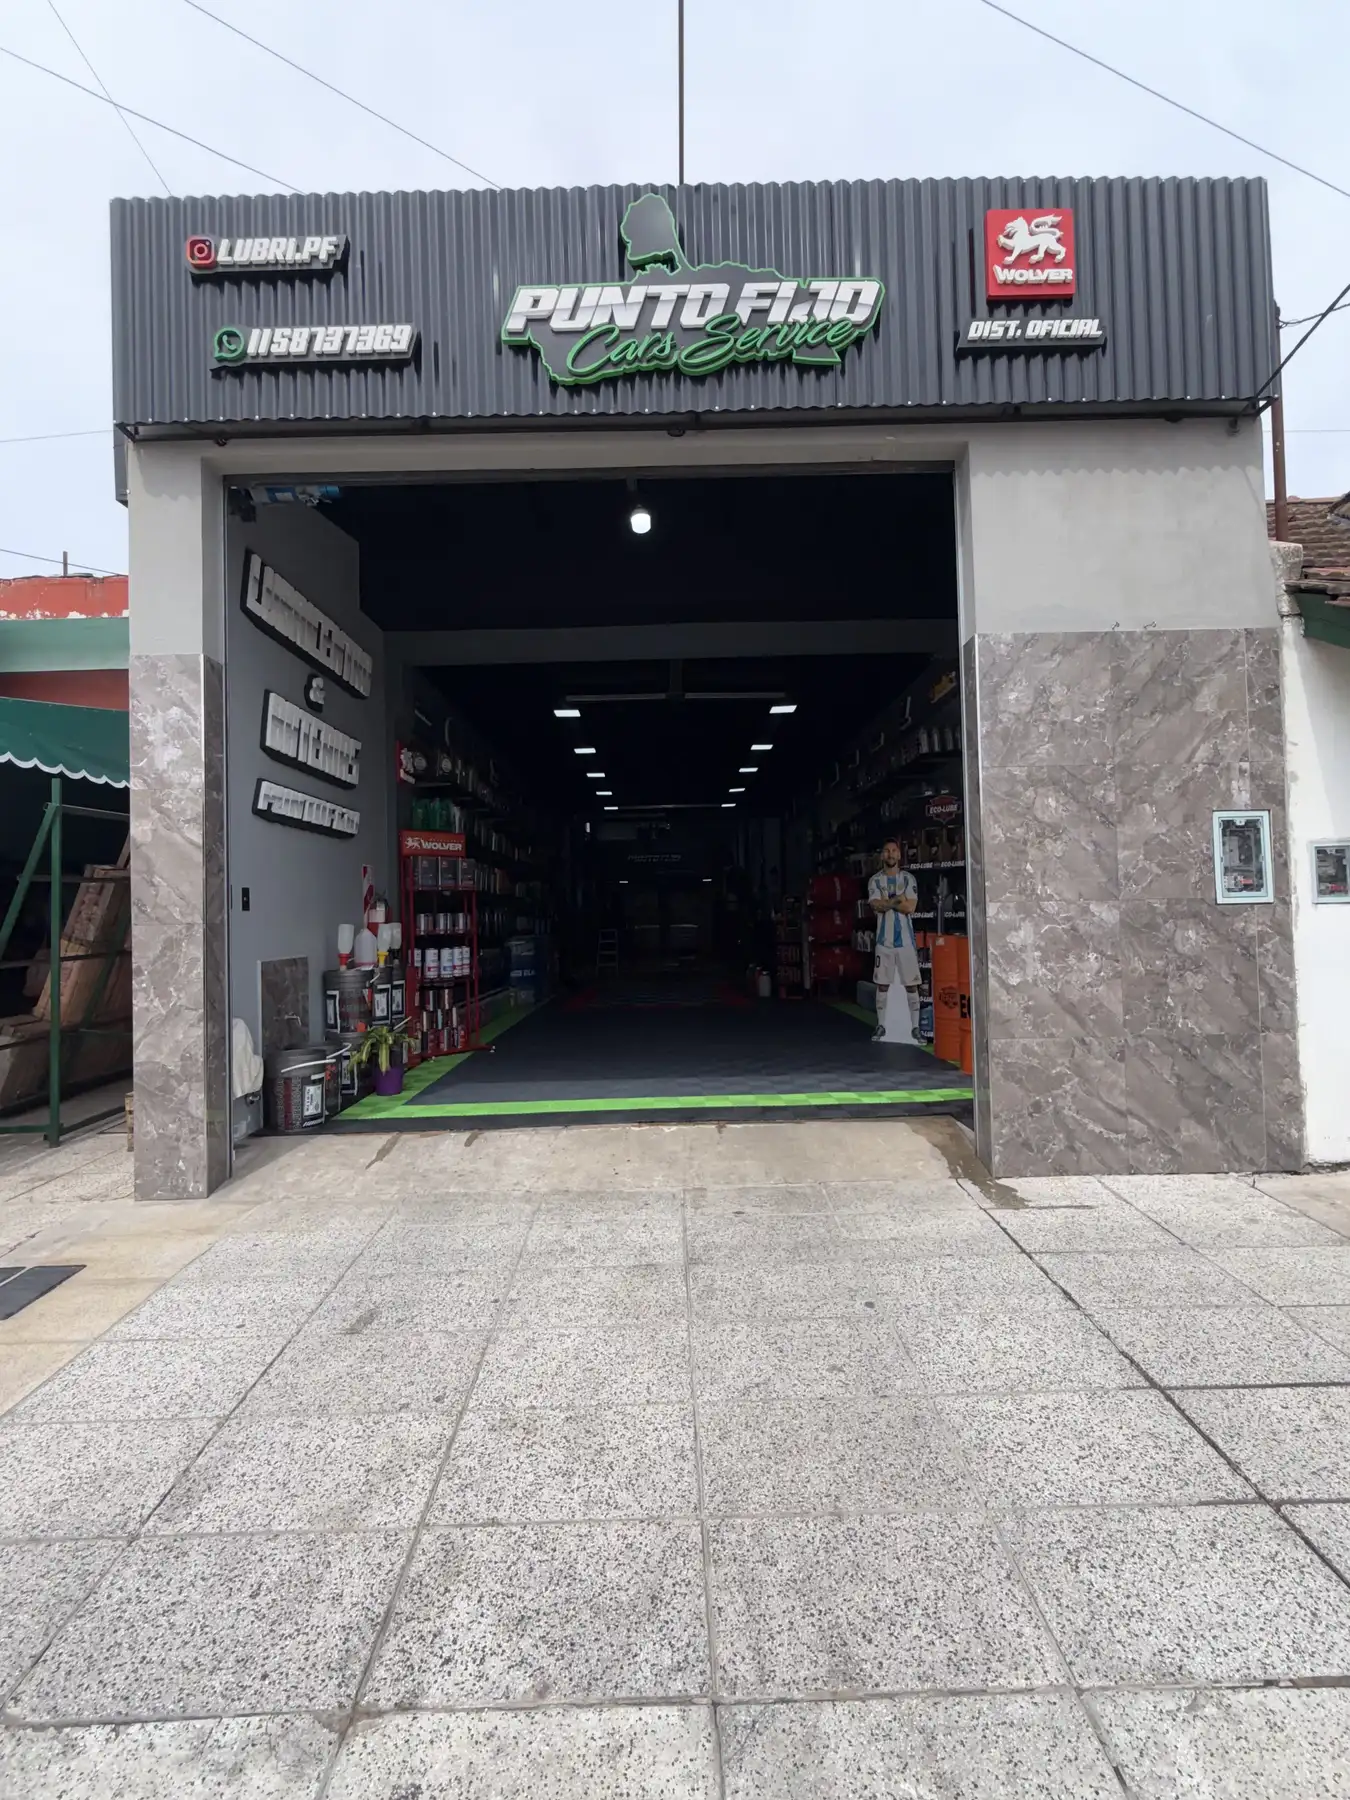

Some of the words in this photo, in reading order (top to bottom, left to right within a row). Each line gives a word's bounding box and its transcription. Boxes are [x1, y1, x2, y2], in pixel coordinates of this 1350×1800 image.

[217, 237, 338, 264] LUBRI.PF
[993, 264, 1073, 284] WOLVER
[506, 283, 730, 332] PUNTO
[247, 325, 413, 356] 1158737369
[566, 324, 677, 374] Cars
[678, 312, 858, 365] Service
[967, 320, 1021, 341] DIST.
[1025, 319, 1103, 340] OFICIAL
[309, 677, 326, 706] &
[929, 803, 958, 814] ECO-LUBE
[420, 838, 463, 851] WOLVER
